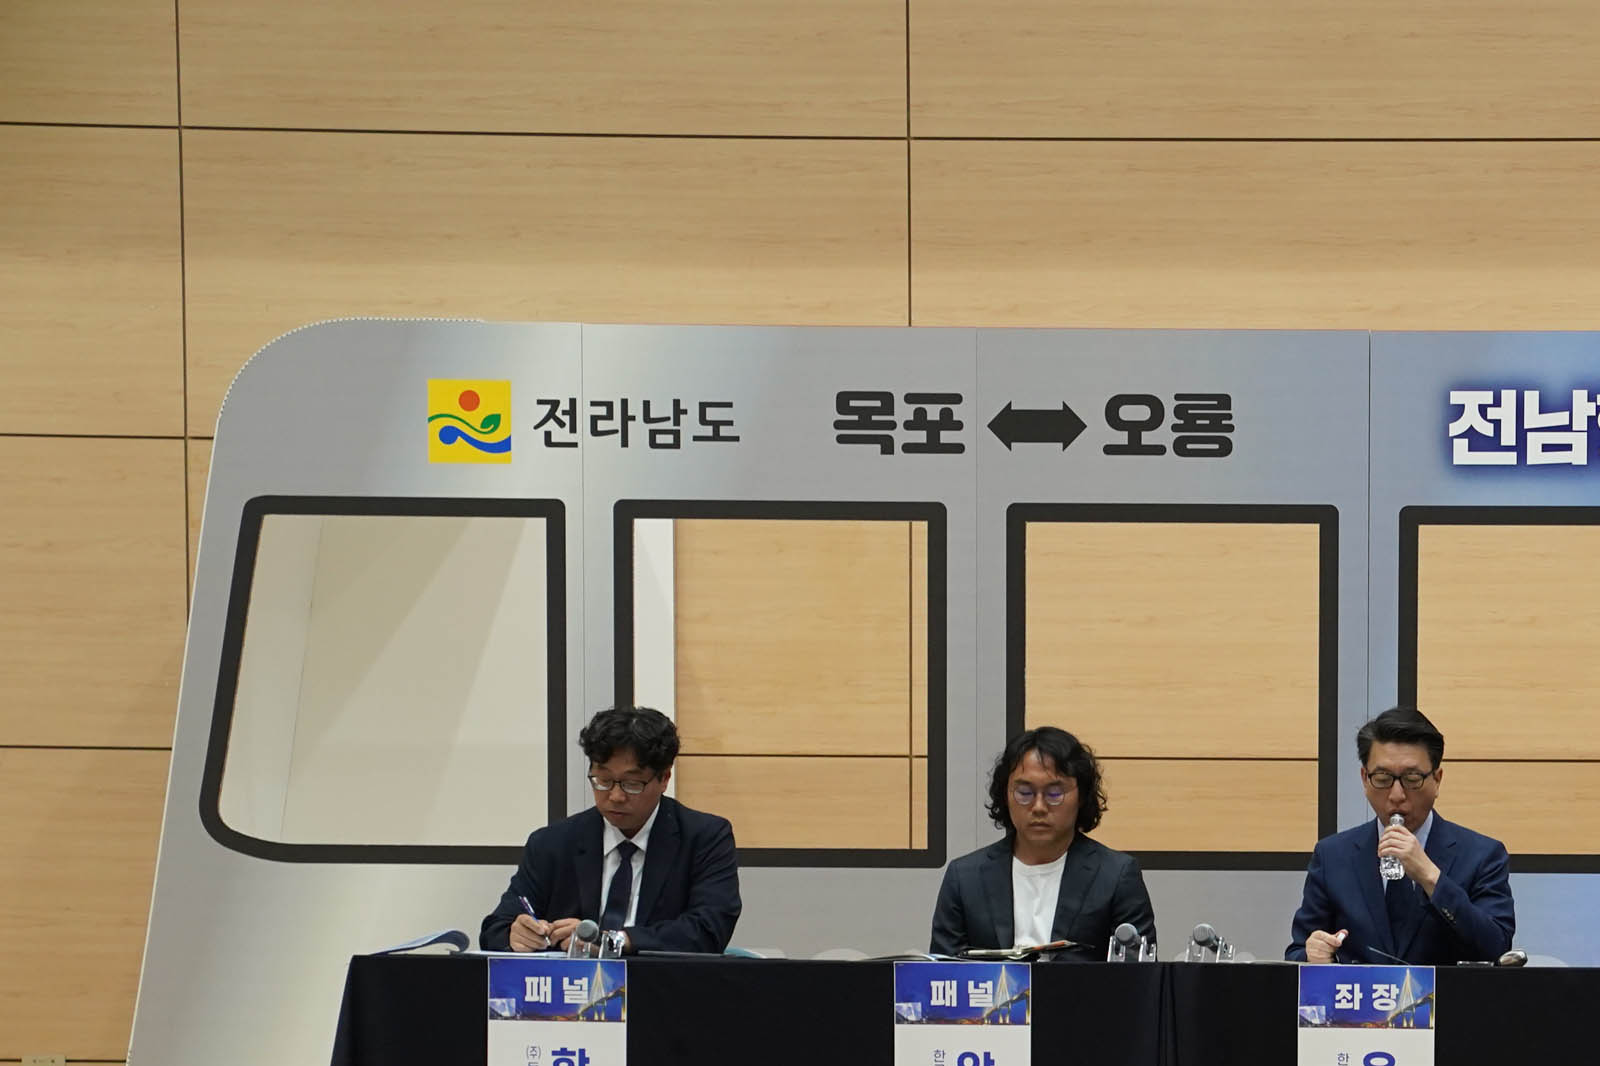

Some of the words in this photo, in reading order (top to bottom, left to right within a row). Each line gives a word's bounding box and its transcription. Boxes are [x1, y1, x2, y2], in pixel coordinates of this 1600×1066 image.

[534, 398, 739, 449] 전라남도
[833, 391, 965, 455] 목포
[1103, 394, 1234, 457] 오룡
[525, 977, 589, 1005] 패널
[931, 981, 993, 1010] 패널
[1335, 984, 1401, 1013] 좌장
